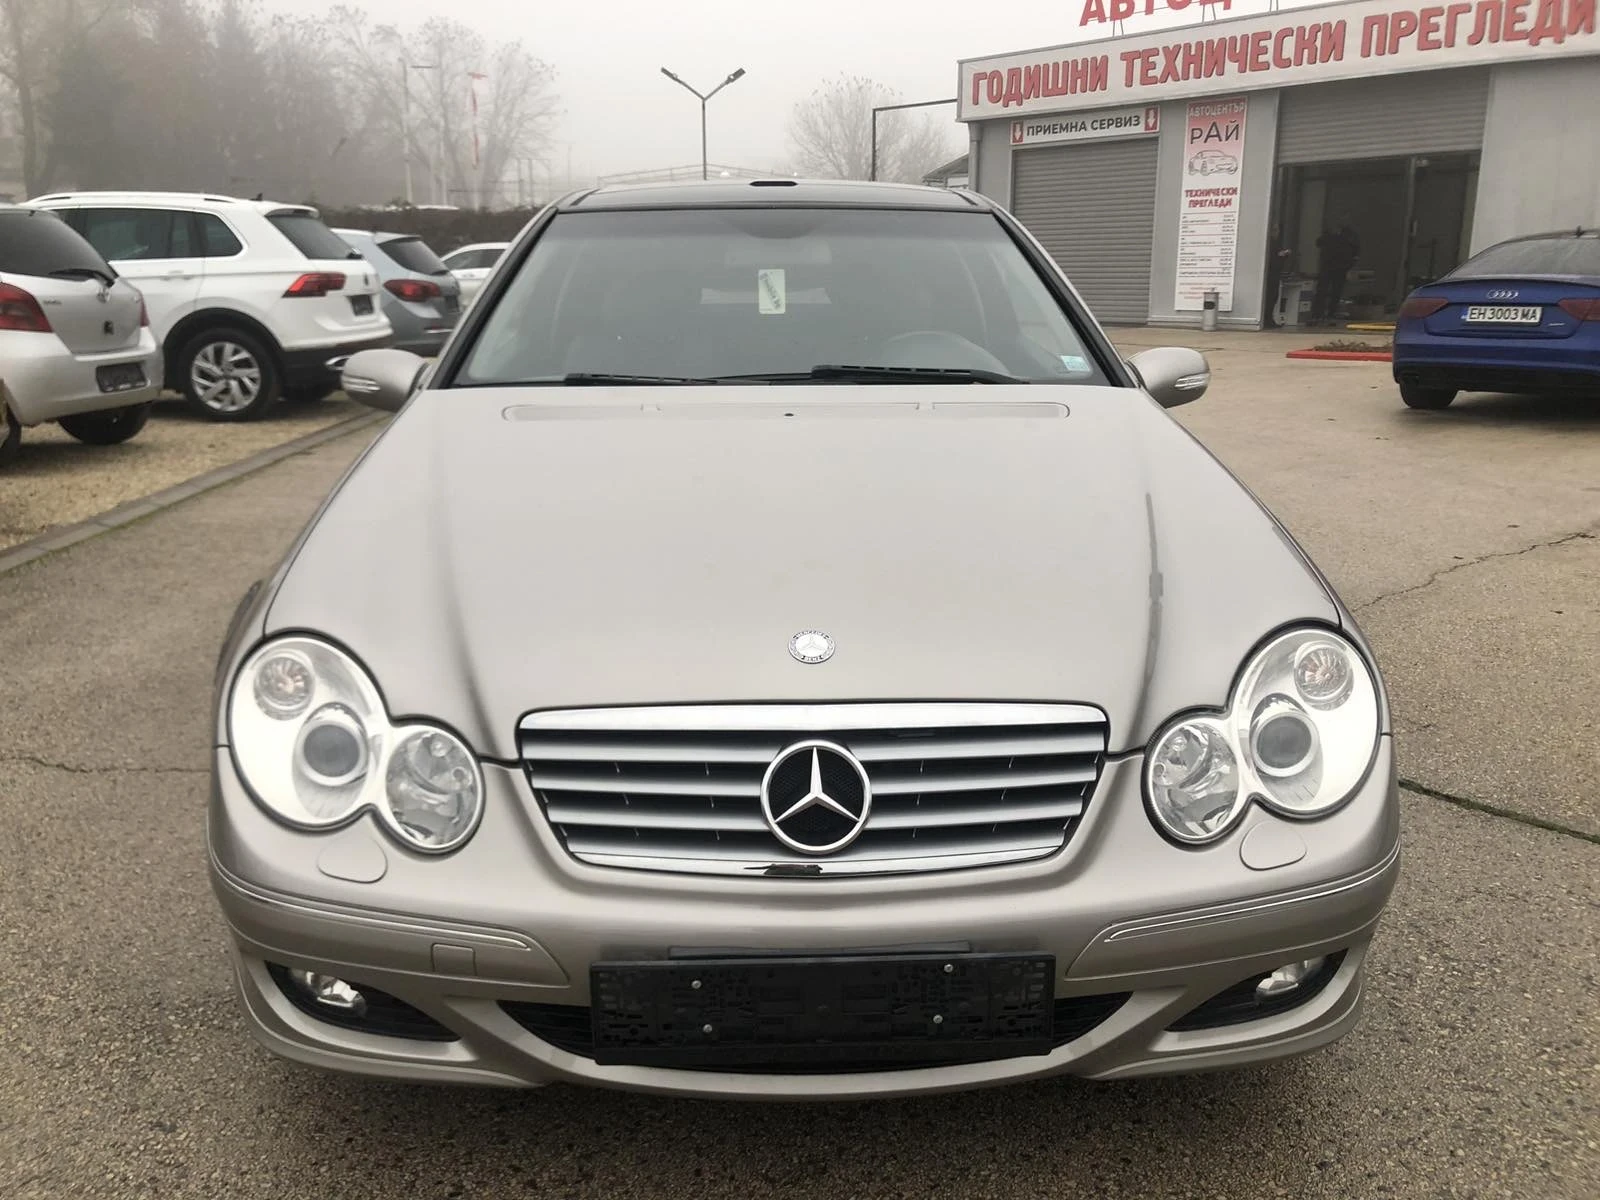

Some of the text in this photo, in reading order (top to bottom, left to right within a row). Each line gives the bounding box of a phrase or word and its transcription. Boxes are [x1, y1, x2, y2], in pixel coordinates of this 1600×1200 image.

[972, 0, 1595, 107] ГОДИШНИ ТЕХНИЧЕСКИ ПРЕГЛЕДИ
[1189, 102, 1244, 117] АВТОЦЕНТЪР
[1027, 115, 1141, 136] ПРИЕМНА СЕРВИЗ
[1190, 120, 1240, 144] РАЙ
[1184, 187, 1238, 198] ТЕХНИЧЕСКИ
[1188, 198, 1233, 208] ПРЕГЛЕДИ
